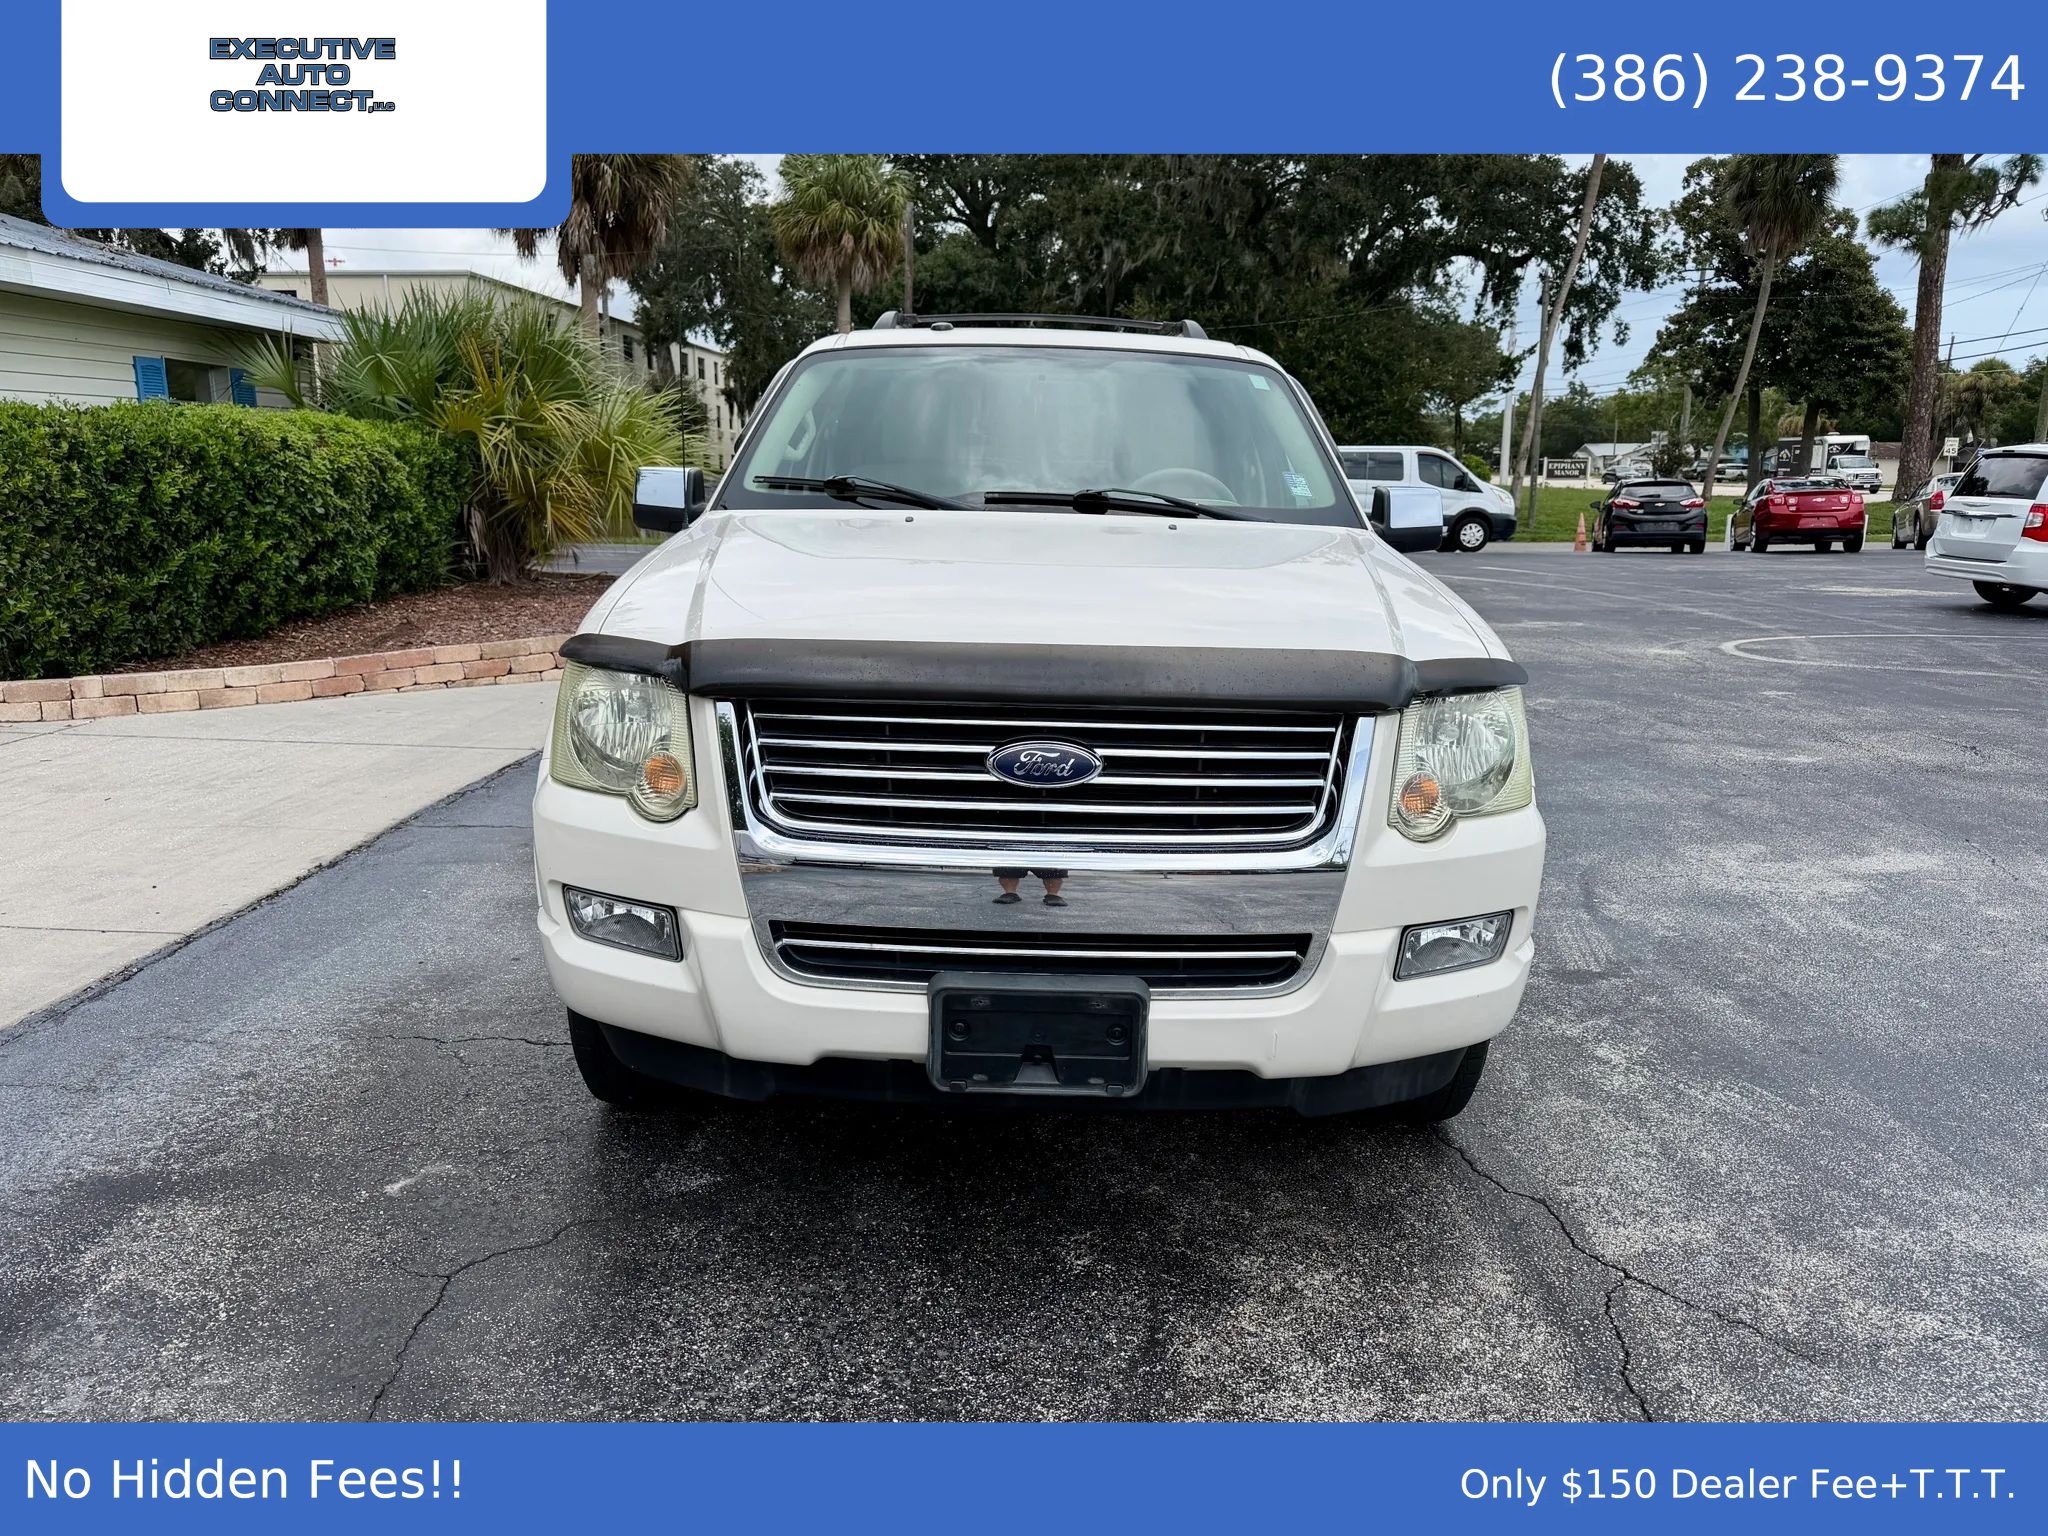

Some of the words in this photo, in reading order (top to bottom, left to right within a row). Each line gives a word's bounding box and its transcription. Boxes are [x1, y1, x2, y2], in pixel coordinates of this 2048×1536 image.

[1945, 447, 1957, 455] 45
[1548, 462, 1586, 470] EPIPHANY
[1013, 750, 1076, 777] Ford
